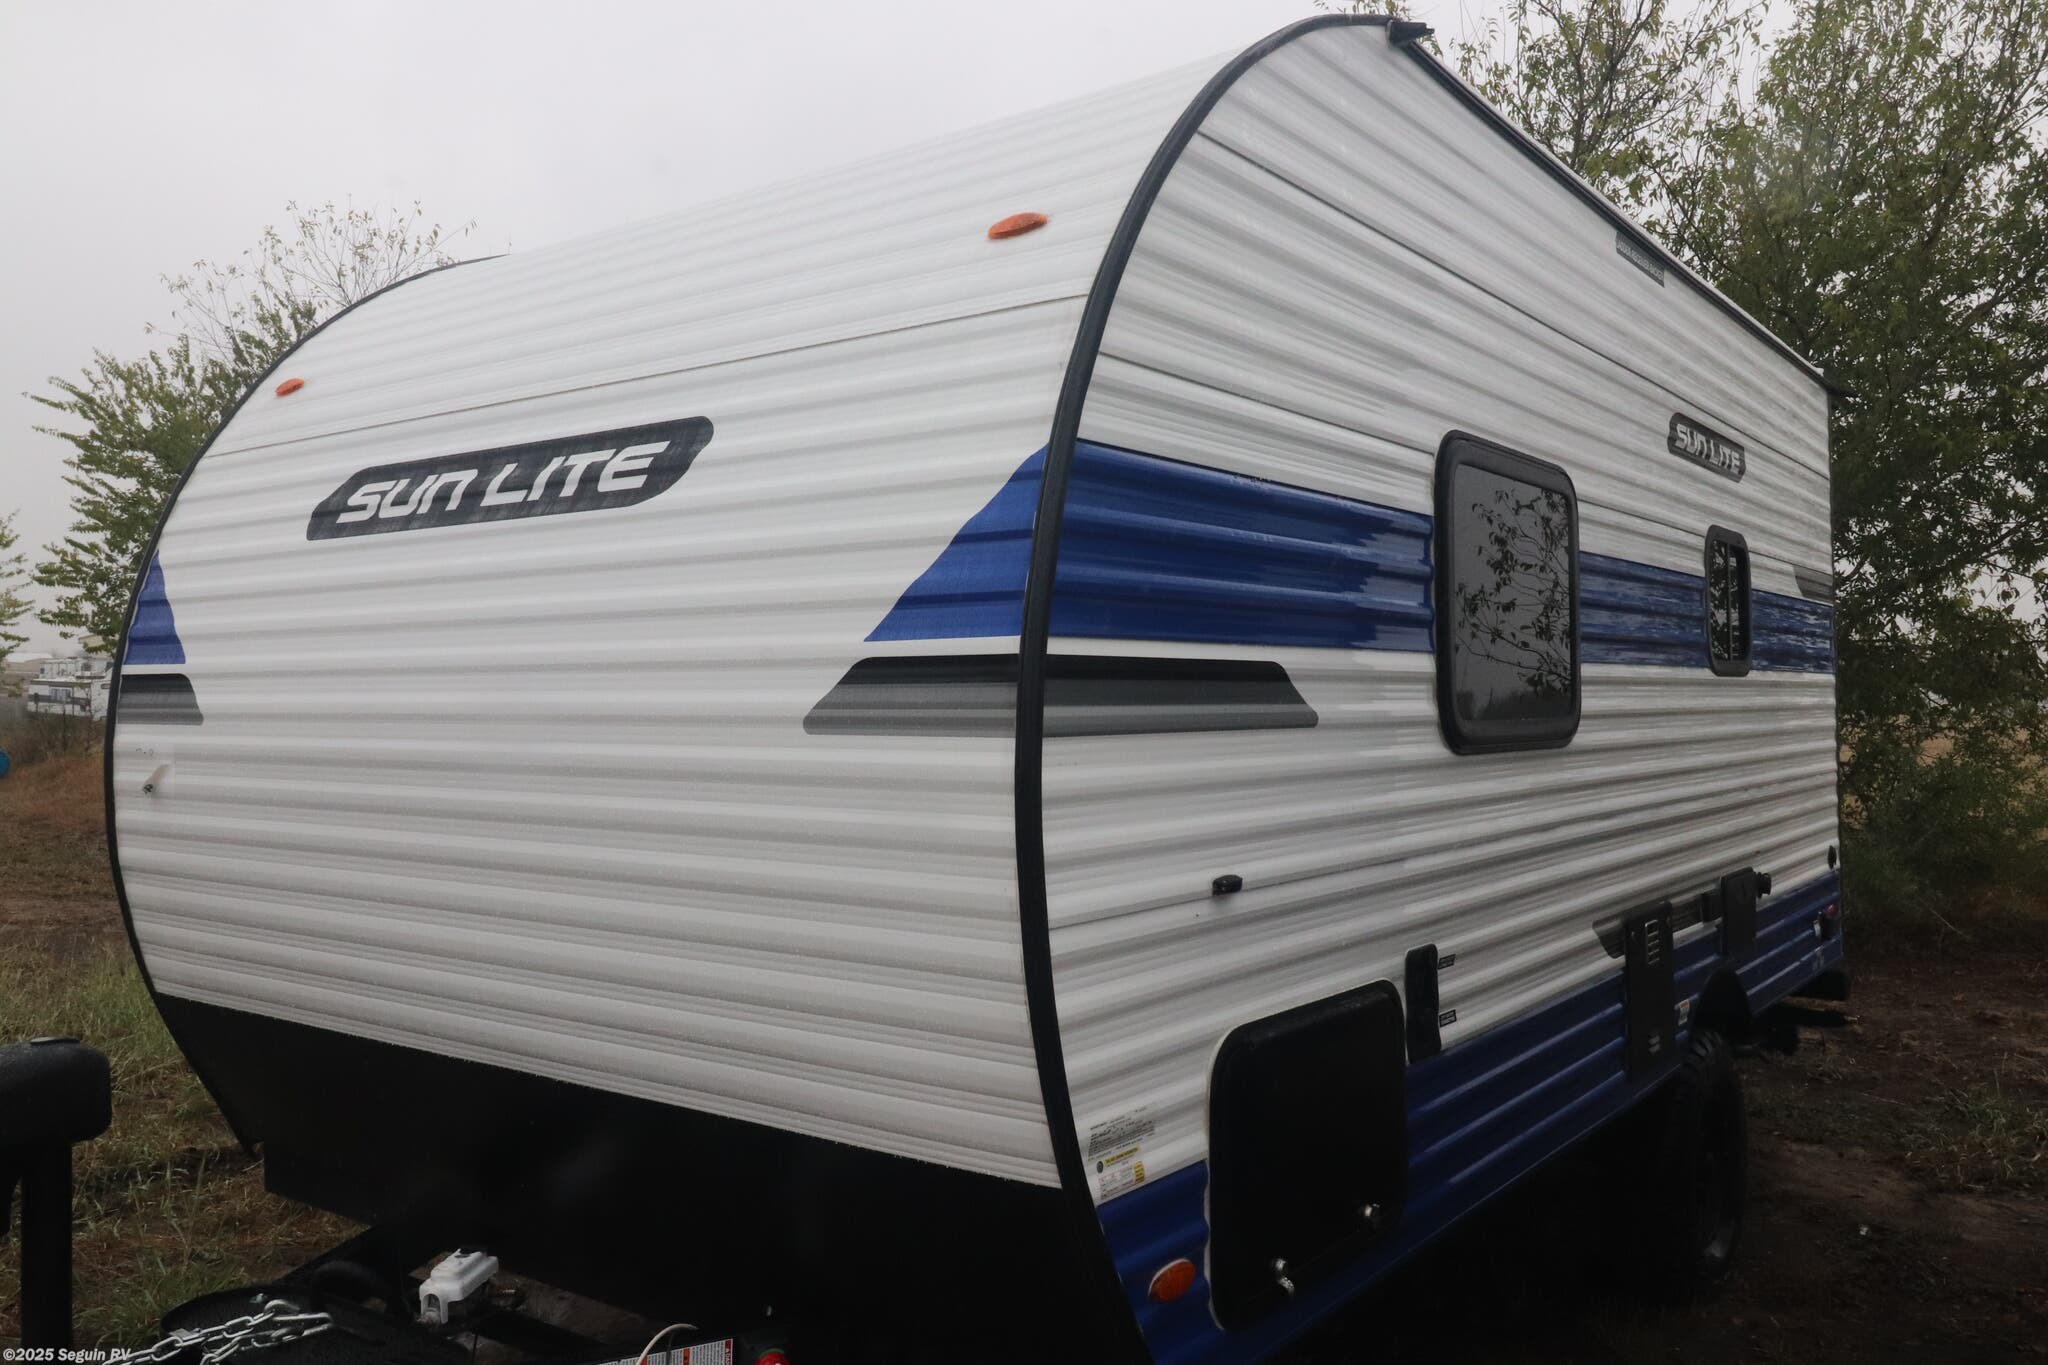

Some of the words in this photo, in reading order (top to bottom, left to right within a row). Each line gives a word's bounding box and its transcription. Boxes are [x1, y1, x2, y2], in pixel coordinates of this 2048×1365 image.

[336, 469, 479, 524] SUN
[480, 440, 671, 507] LITE
[1675, 423, 1707, 458] SUN
[1709, 439, 1741, 475] LITE
